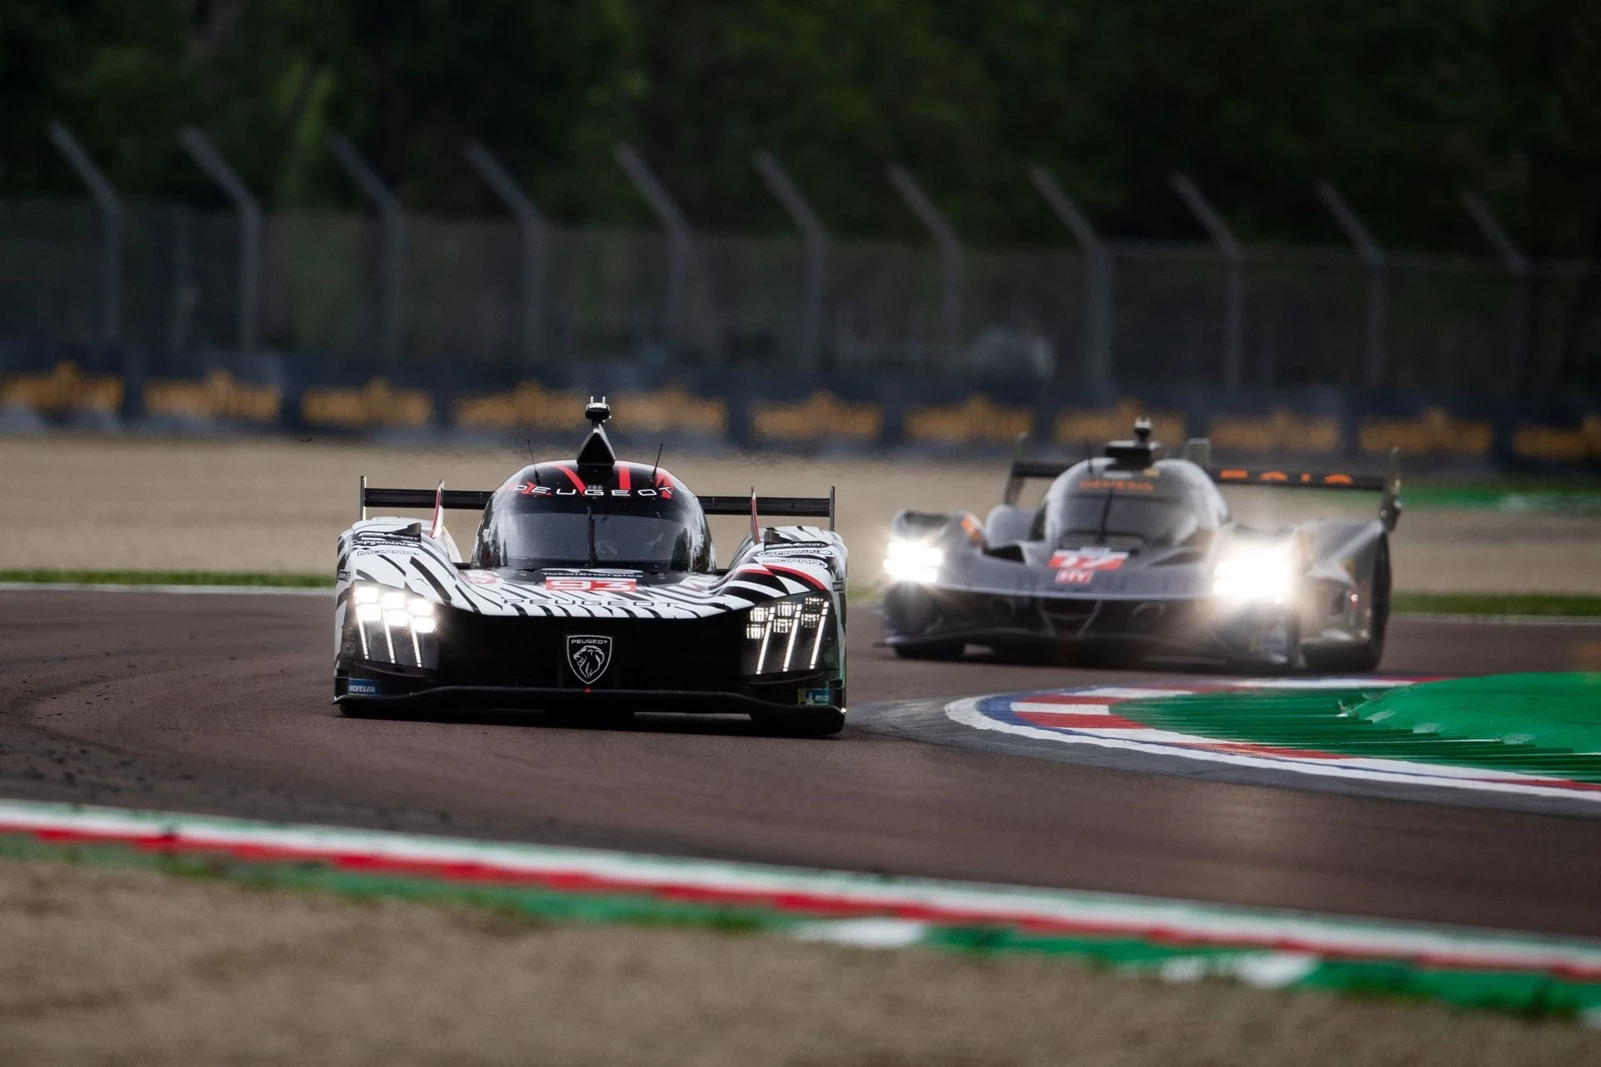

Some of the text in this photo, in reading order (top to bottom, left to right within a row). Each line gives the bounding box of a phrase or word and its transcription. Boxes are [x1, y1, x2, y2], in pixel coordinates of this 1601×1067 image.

[512, 484, 673, 497] PEUGEOT
[551, 580, 632, 591] 93
[503, 598, 678, 607] PEUGEOT
